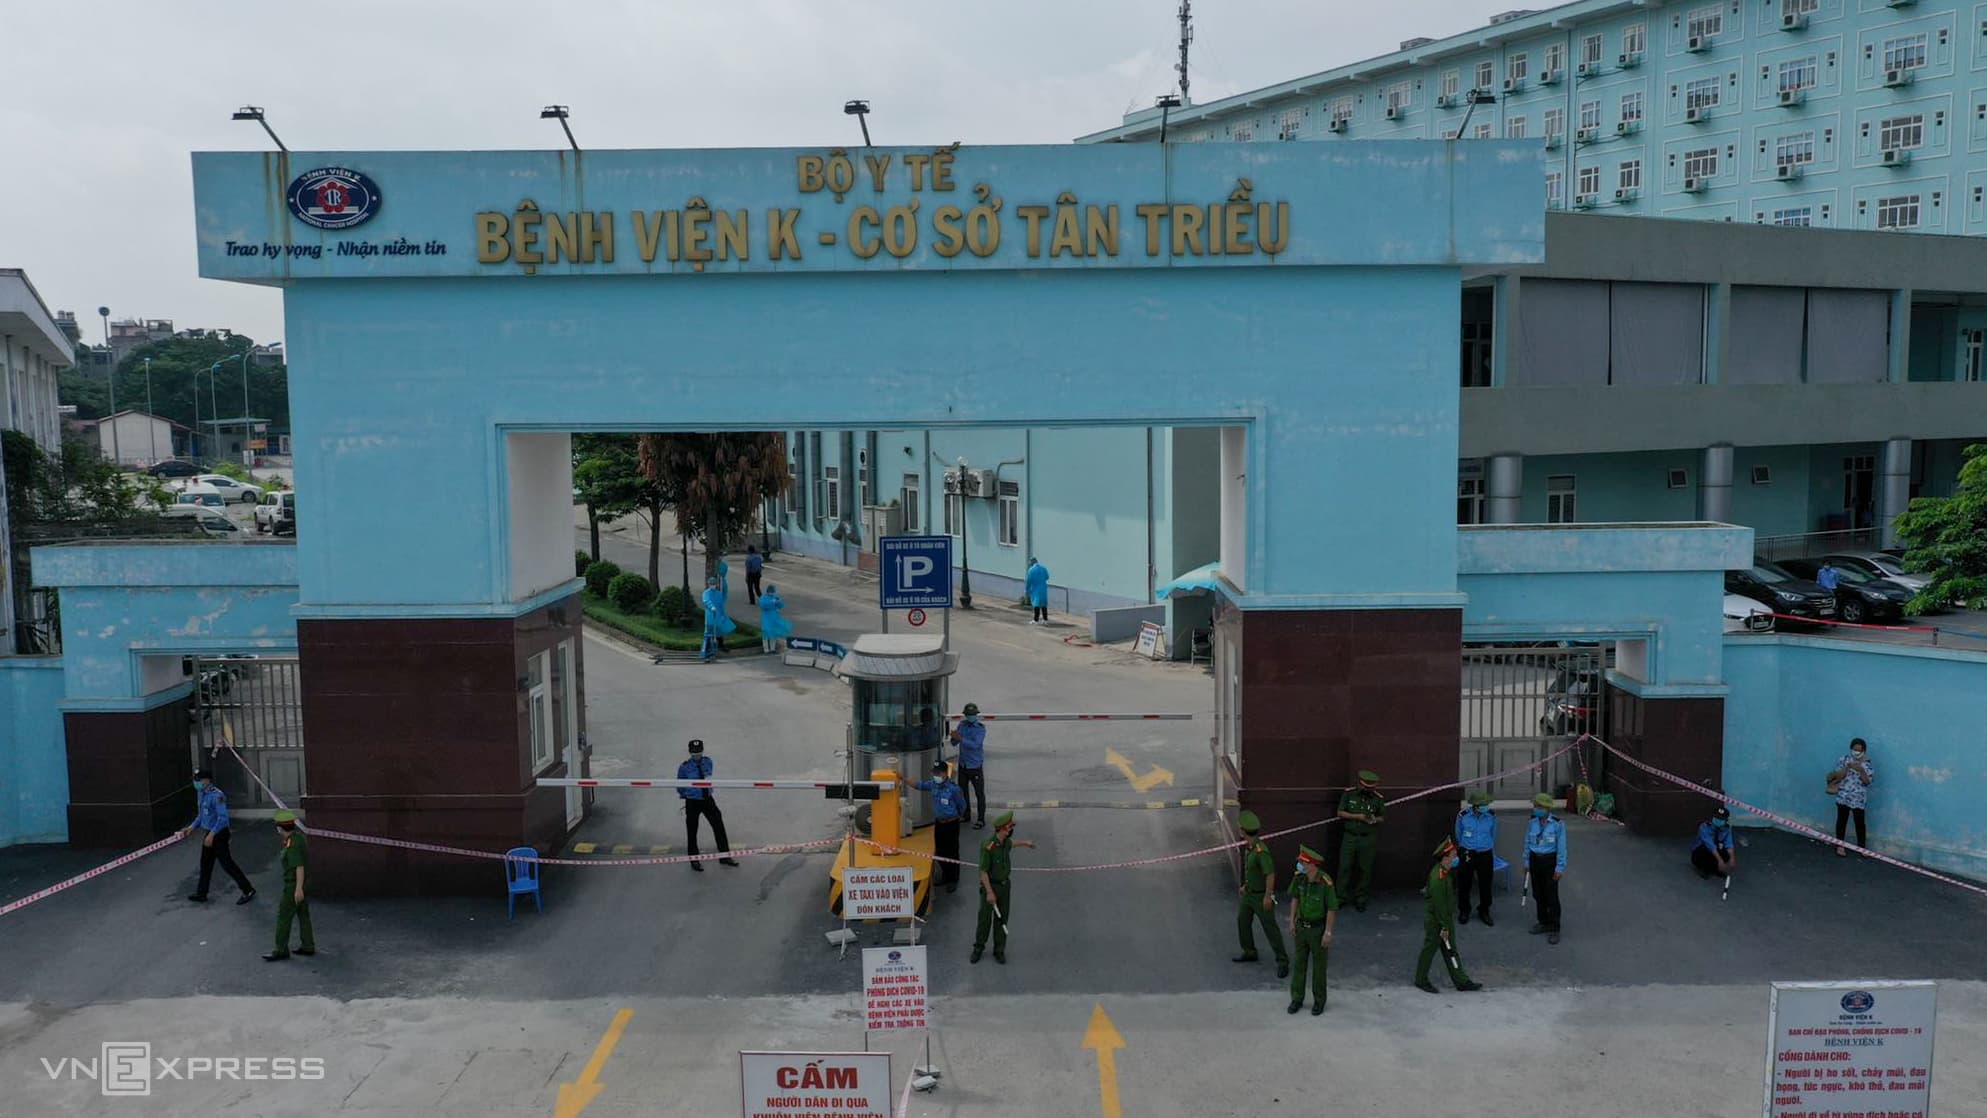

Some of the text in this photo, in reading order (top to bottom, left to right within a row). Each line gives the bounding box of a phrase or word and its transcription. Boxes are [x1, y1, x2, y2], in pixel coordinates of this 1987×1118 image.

[797, 141, 961, 204] BỘ Y TẾ
[475, 177, 1290, 275] BỆNH VIỆN K - CƠ SỞ TÂN TRIỀU
[225, 241, 258, 256] Trao
[262, 242, 280, 260] hy
[285, 244, 322, 259] vọng
[336, 241, 379, 259] Nhận
[382, 237, 421, 255] niềm
[425, 240, 446, 255] tin
[904, 556, 933, 587] P
[848, 890, 857, 900] XE
[860, 889, 874, 900] TAXI
[892, 887, 908, 901] VIỆN
[875, 903, 901, 912] KHÁCH
[777, 1059, 858, 1089] CẤM
[767, 1096, 868, 1108] NGƯỜI DÂN ĐI QUA
